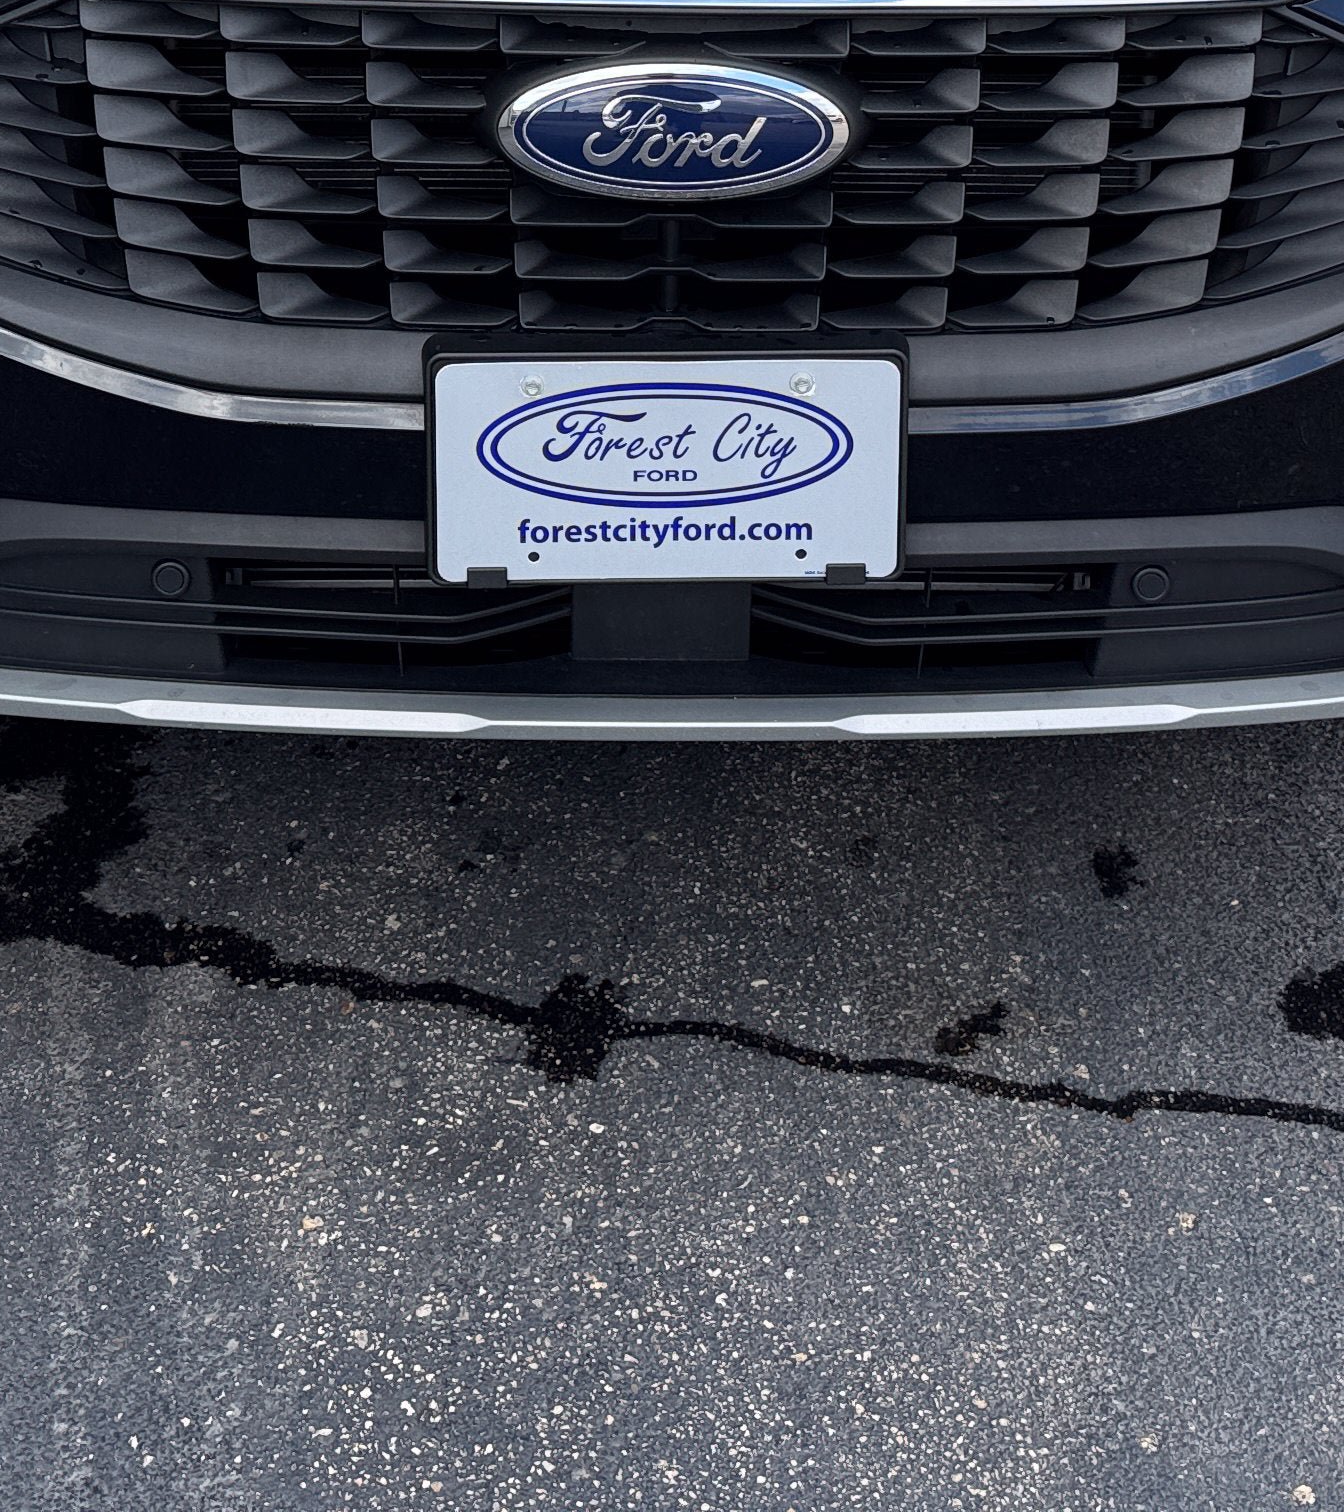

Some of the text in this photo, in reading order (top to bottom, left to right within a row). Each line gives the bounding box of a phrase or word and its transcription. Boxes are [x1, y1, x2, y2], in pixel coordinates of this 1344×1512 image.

[582, 94, 767, 169] Ford
[542, 410, 798, 478] Forest City
[633, 469, 698, 482] FORD
[517, 516, 813, 548] forestcityford.com
